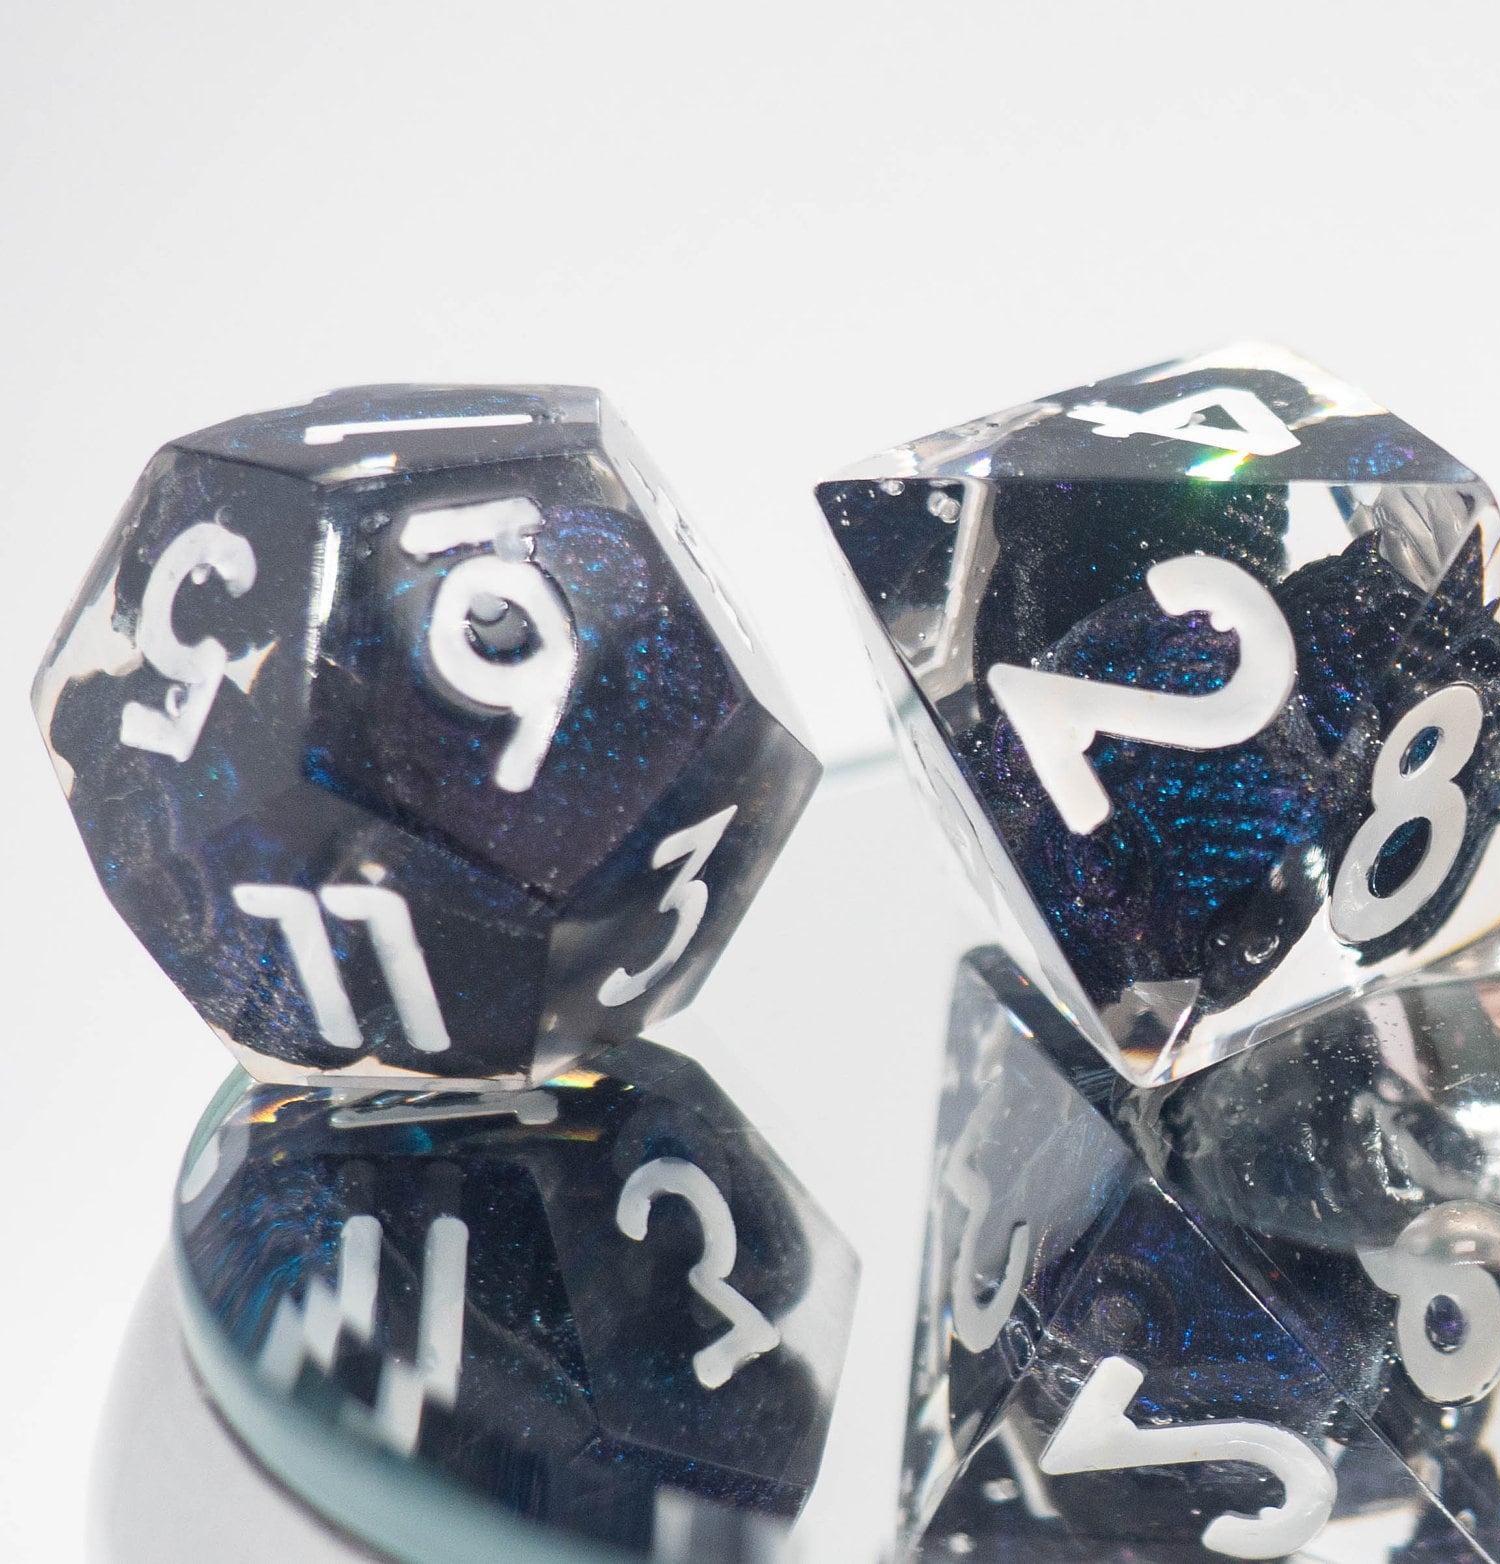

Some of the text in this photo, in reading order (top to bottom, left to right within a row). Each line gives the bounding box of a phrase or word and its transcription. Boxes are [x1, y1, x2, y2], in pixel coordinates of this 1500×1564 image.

[987, 553, 1298, 836] 2
[1330, 681, 1484, 945] 8
[598, 804, 738, 1008] 3
